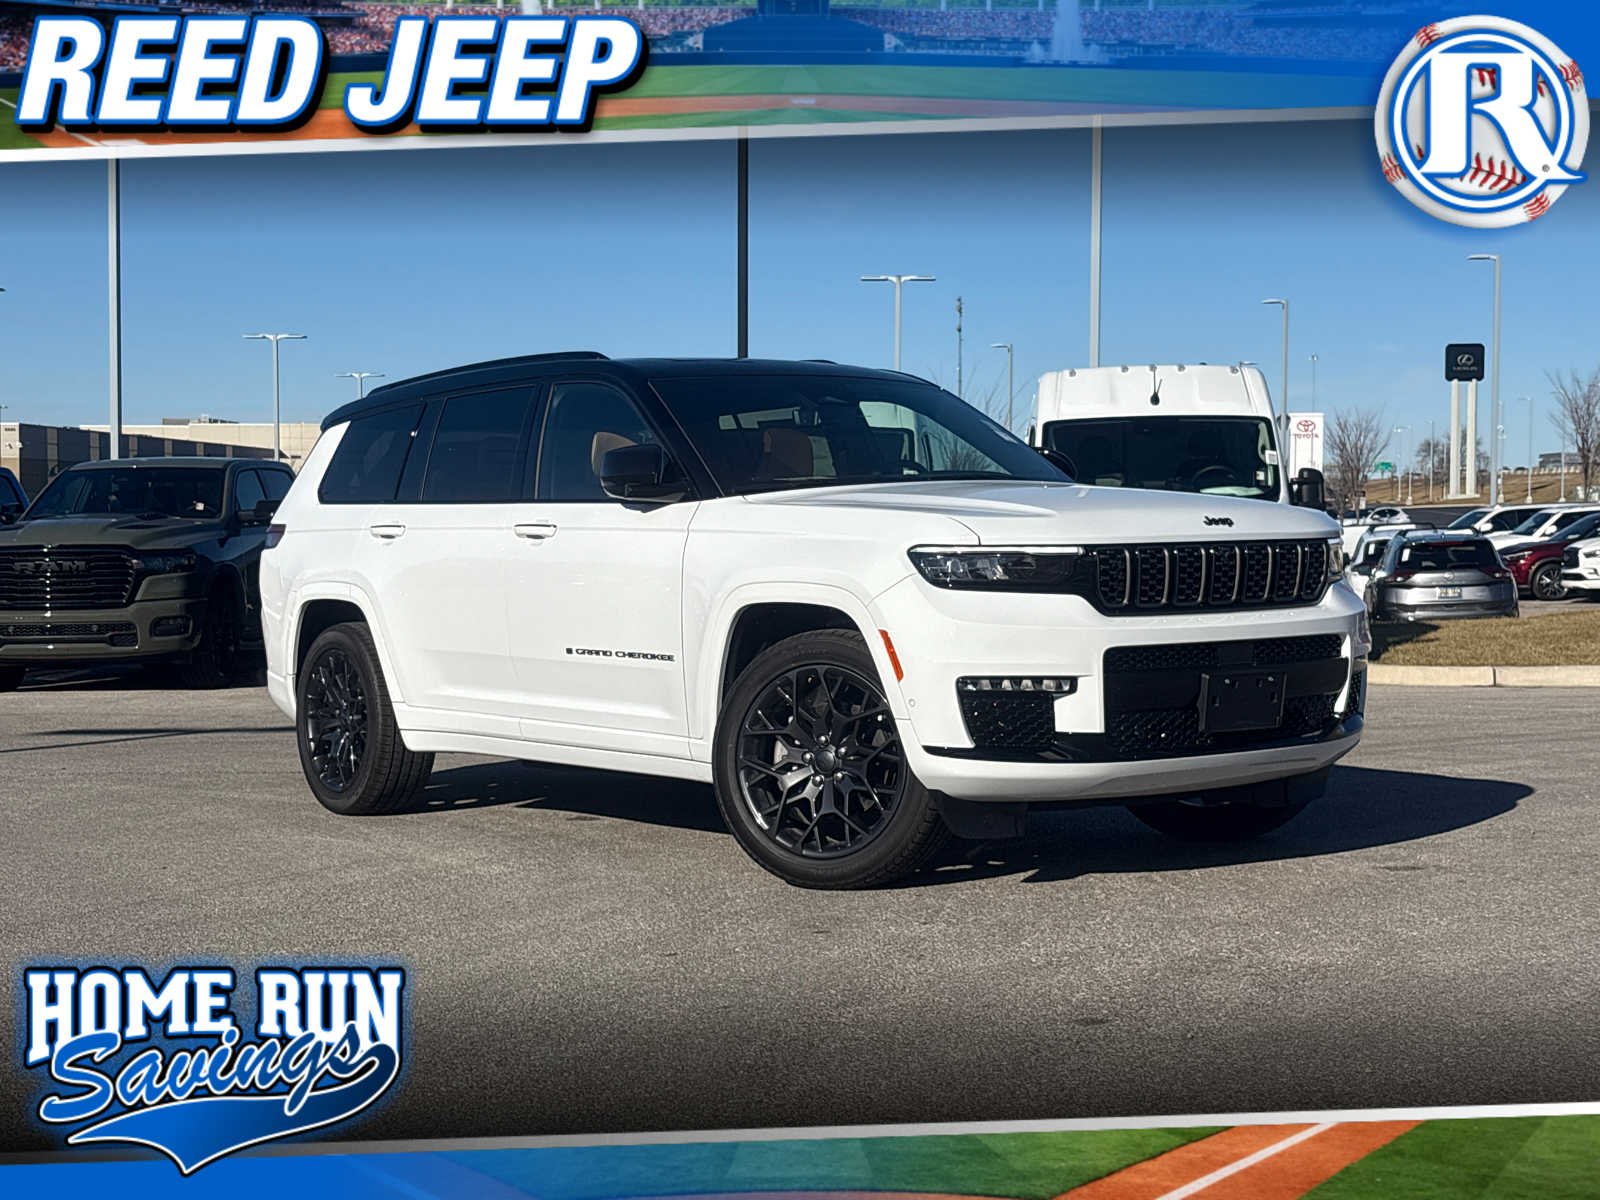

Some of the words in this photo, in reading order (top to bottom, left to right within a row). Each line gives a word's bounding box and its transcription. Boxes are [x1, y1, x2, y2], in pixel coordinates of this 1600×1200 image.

[1203, 515, 1234, 528] Jeep
[14, 560, 87, 574] RAM
[575, 648, 612, 657] GRAND
[614, 650, 675, 662] CHEROKEE
